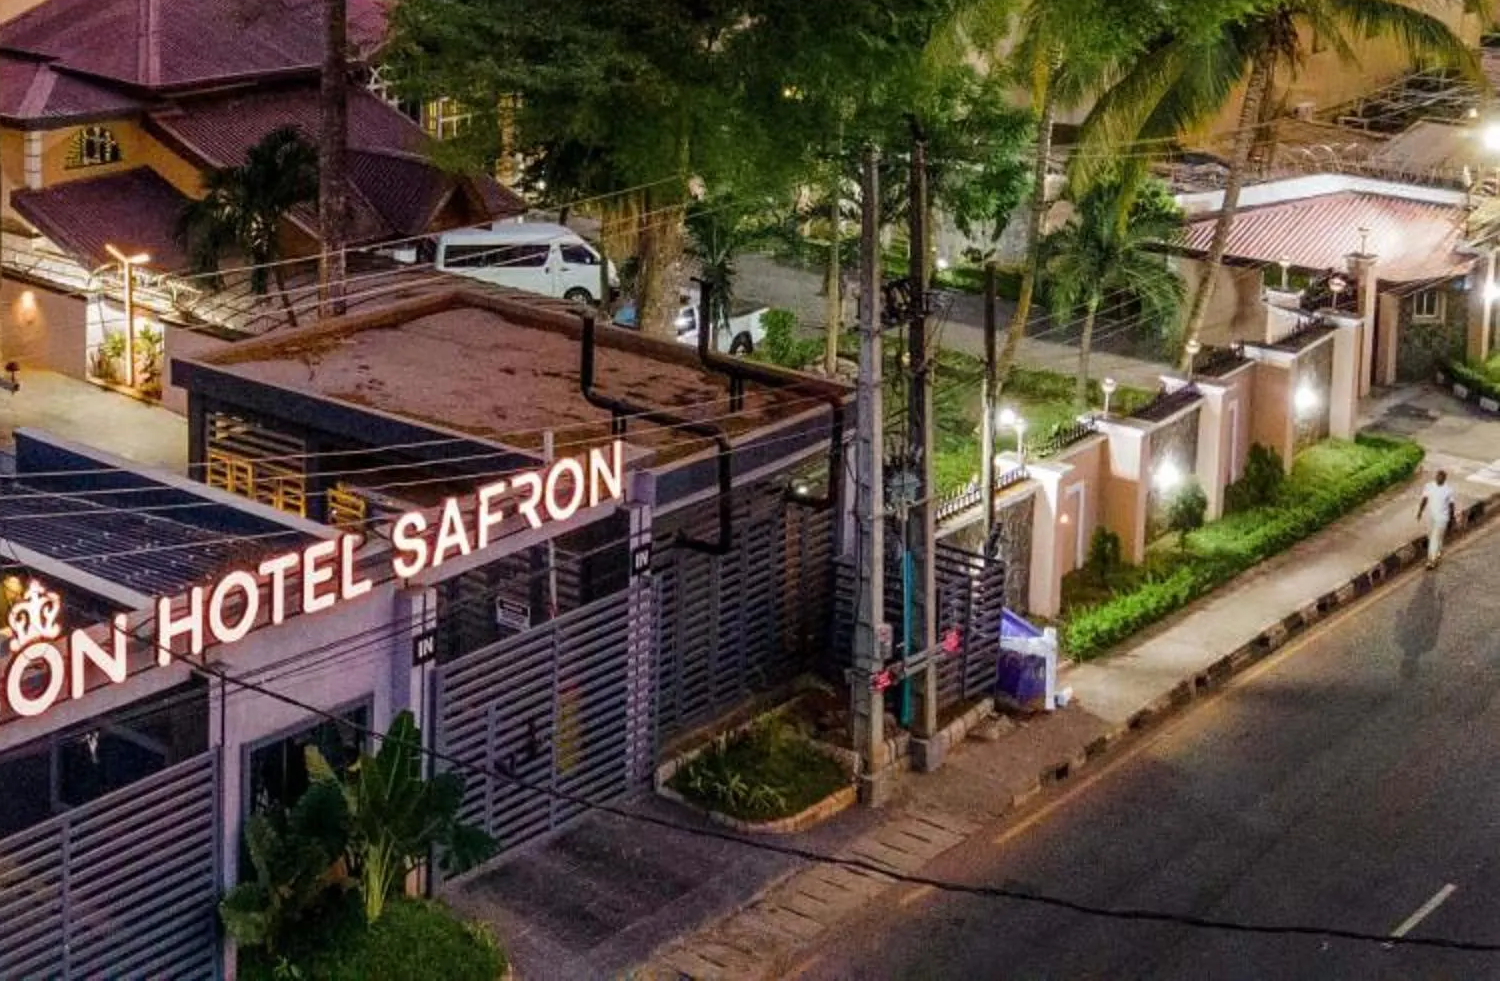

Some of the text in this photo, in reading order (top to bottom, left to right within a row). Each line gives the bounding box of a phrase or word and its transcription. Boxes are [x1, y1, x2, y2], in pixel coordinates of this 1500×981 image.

[157, 533, 373, 668] HOTEL
[391, 439, 622, 578] SAFRON
[635, 549, 649, 569] IN
[417, 635, 434, 658] IN
